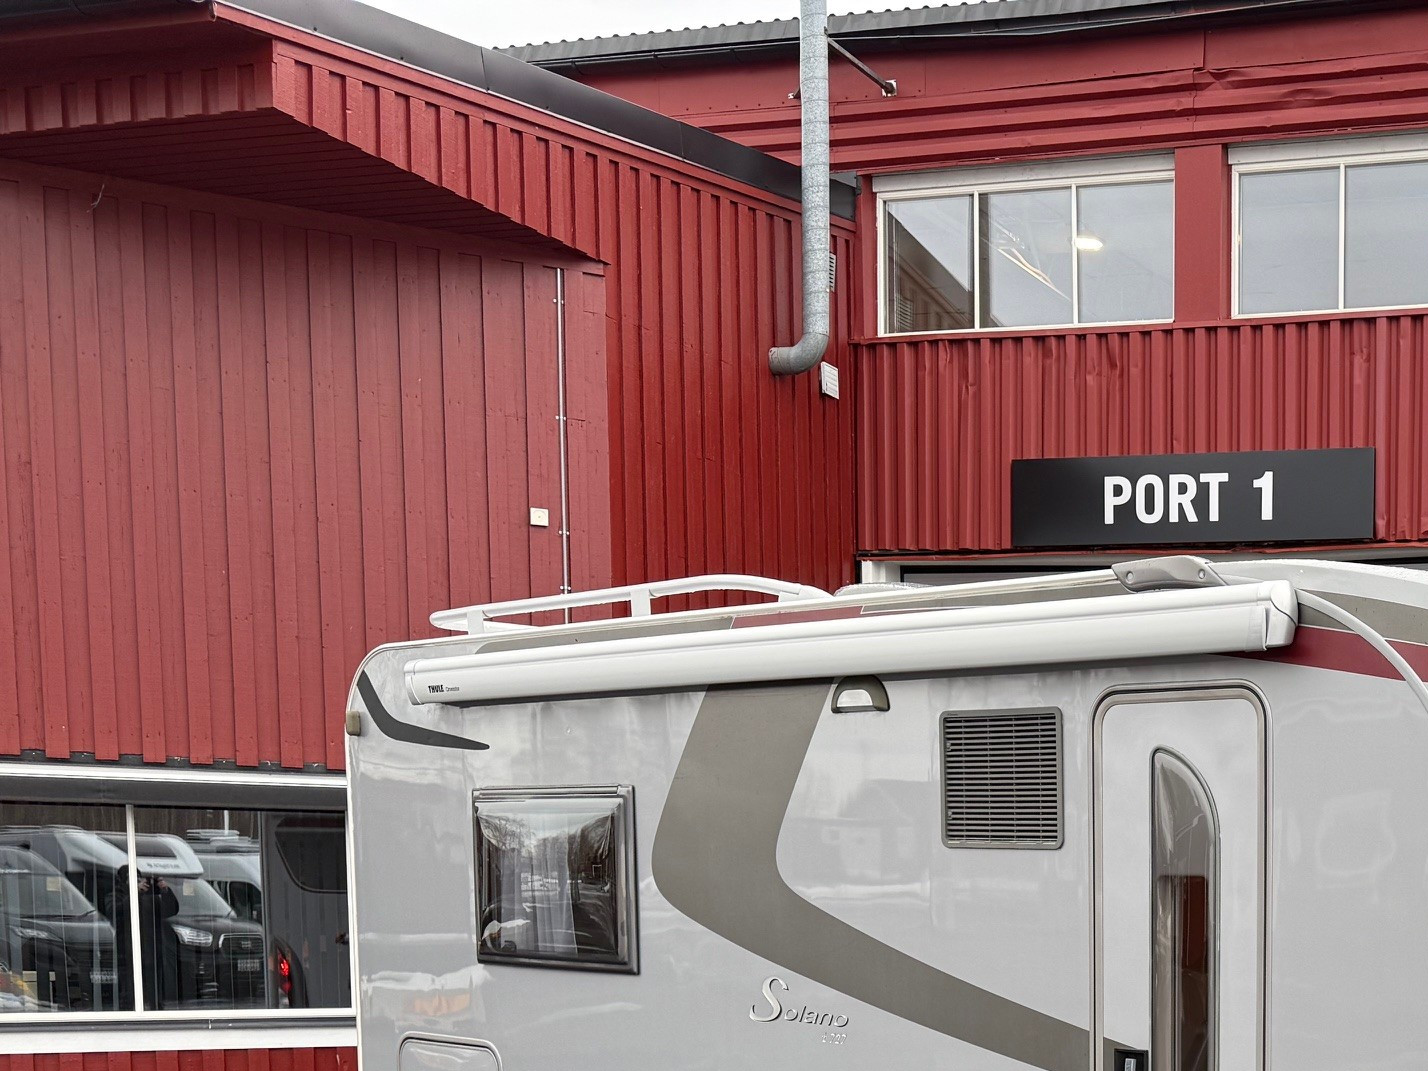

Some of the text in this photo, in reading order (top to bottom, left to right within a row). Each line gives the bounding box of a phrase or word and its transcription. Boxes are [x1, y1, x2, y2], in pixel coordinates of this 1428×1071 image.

[1103, 470, 1274, 525] PORT 1
[749, 976, 850, 1028] Solano
